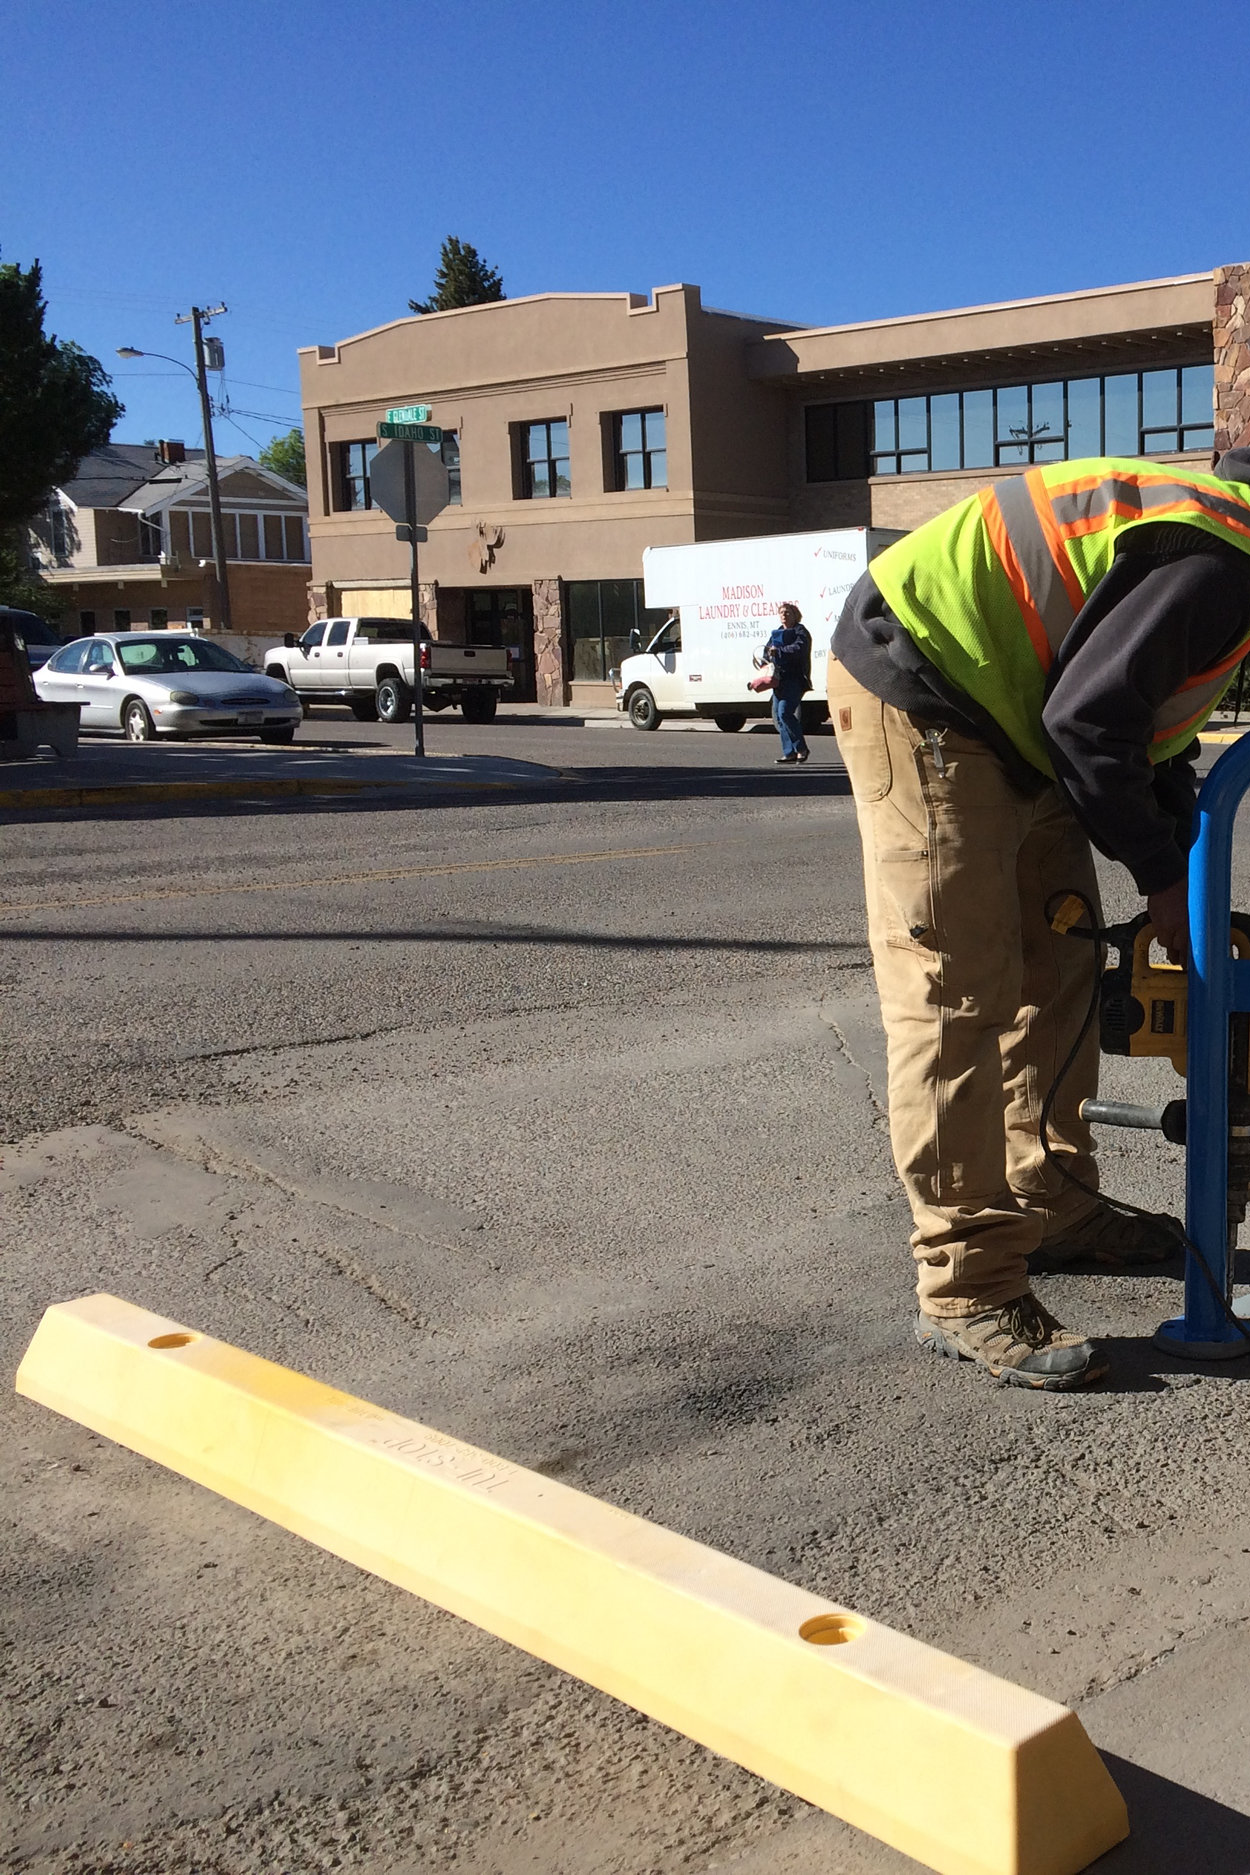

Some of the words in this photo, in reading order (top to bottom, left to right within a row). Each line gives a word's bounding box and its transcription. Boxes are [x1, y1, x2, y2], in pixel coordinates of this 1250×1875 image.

[382, 424, 388, 437] S
[394, 425, 424, 439] IDAHO
[430, 428, 440, 441] ST
[823, 549, 856, 562] UNIFORMS
[722, 584, 764, 600] MADISON
[828, 582, 856, 596] LAUNDR
[699, 604, 741, 620] LAUNDRY
[742, 604, 750, 618] &
[750, 600, 800, 618] CLEAN
[749, 621, 760, 629] MT
[814, 648, 826, 659] DRY
